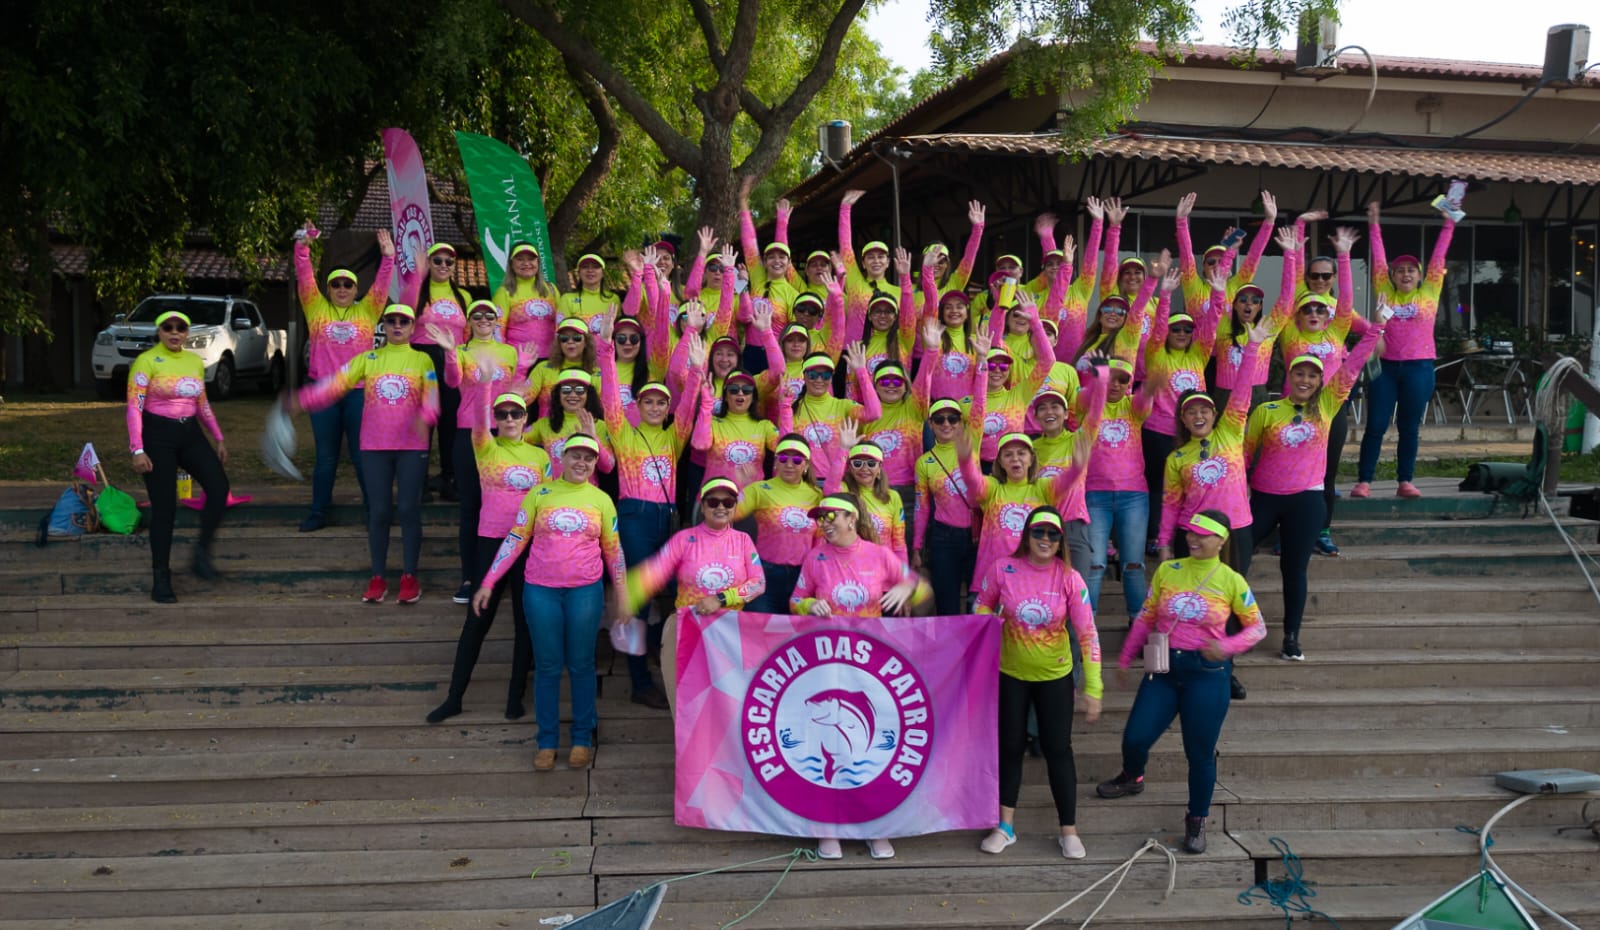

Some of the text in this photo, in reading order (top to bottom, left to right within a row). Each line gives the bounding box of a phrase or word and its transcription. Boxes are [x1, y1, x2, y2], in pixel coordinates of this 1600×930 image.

[748, 636, 929, 788] PESCARIA DAS PATROAS
